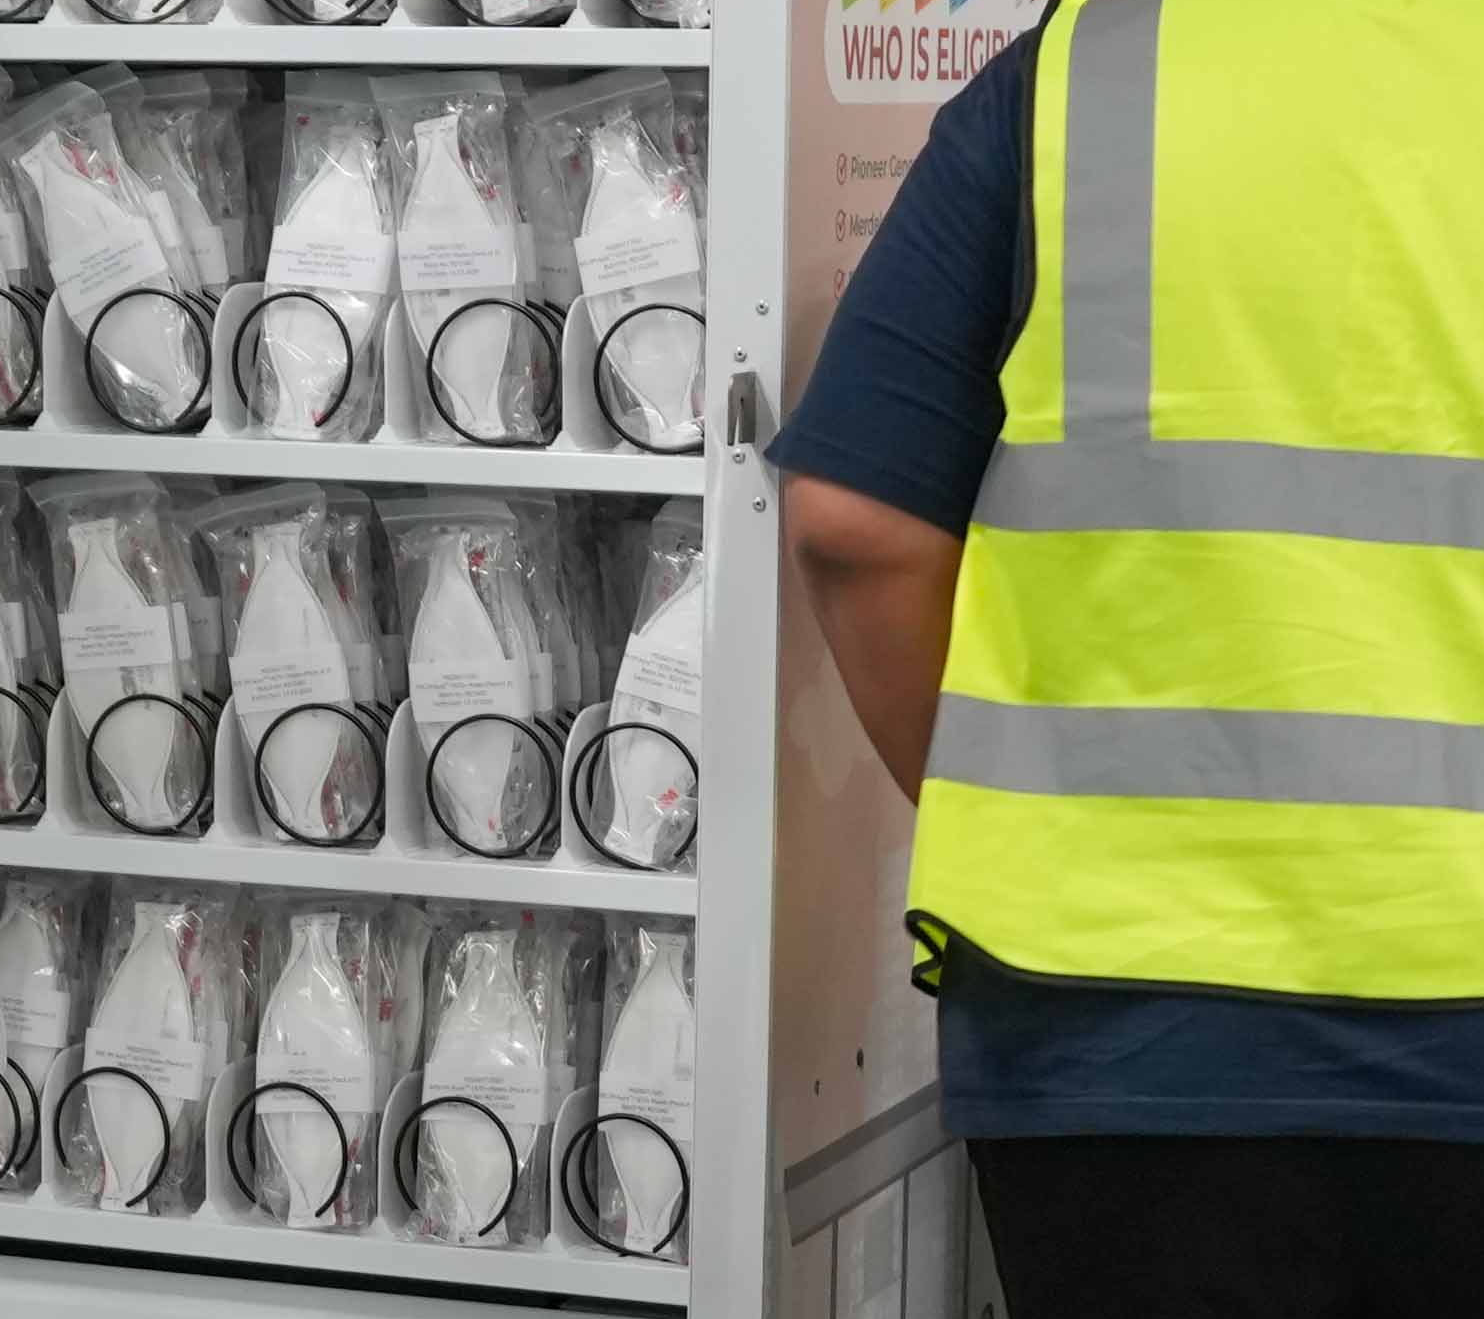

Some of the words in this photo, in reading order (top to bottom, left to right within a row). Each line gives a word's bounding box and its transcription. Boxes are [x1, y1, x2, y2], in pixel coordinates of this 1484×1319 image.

[842, 24, 904, 81] WHO
[911, 25, 930, 81] IS
[851, 154, 887, 179] Pioneer
